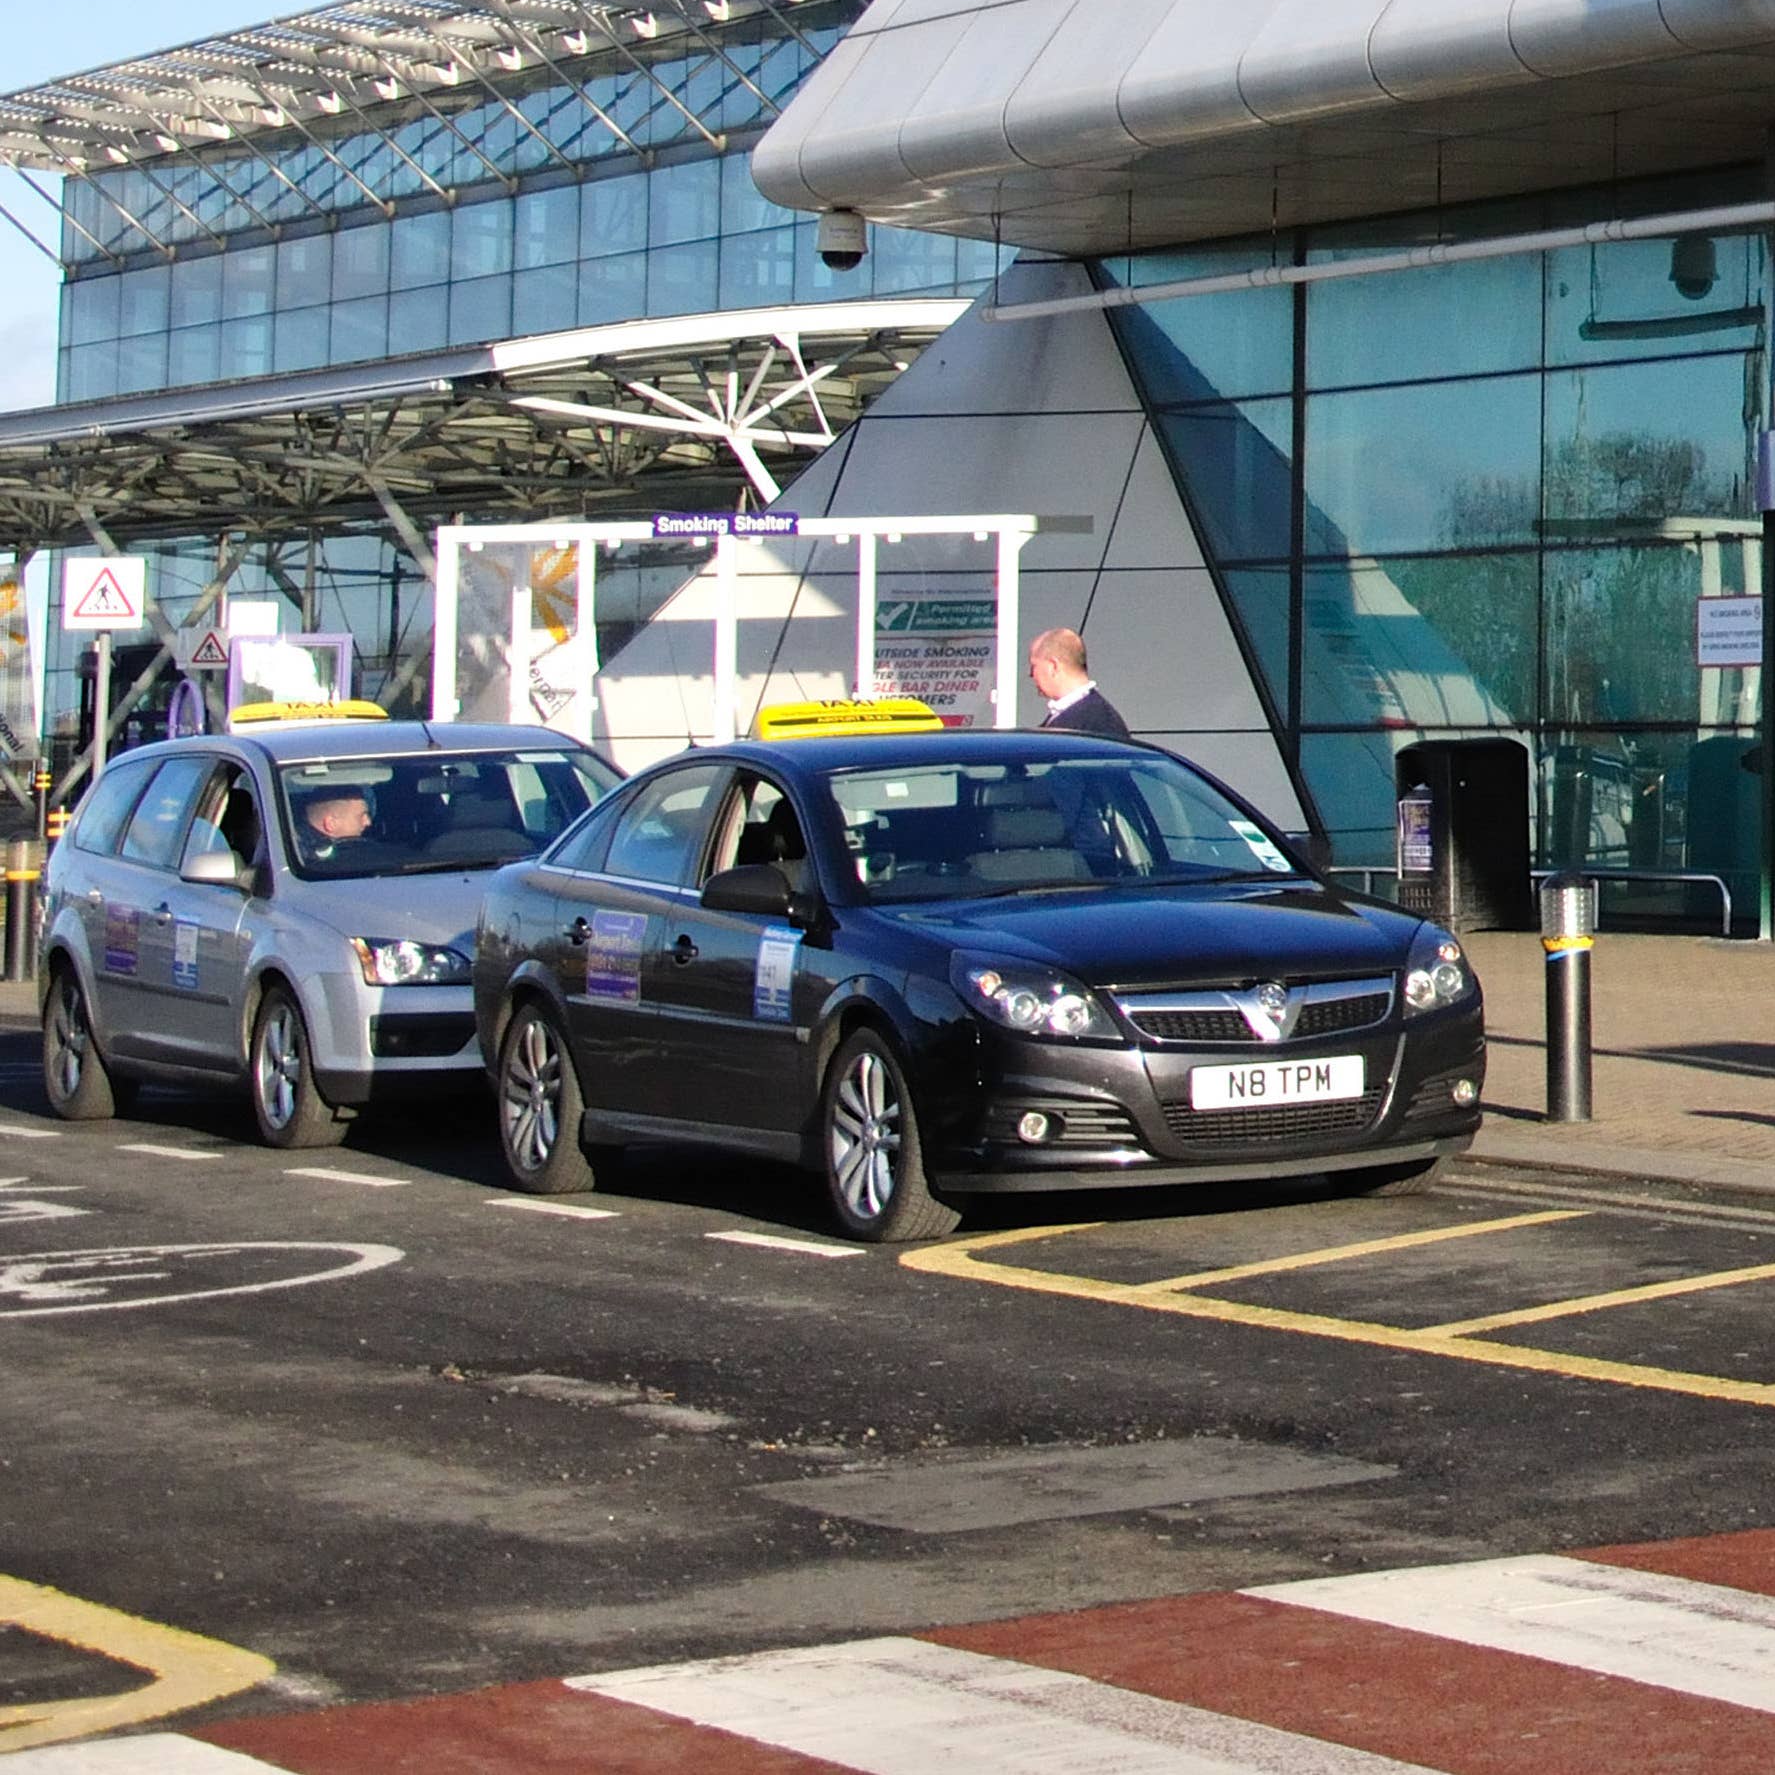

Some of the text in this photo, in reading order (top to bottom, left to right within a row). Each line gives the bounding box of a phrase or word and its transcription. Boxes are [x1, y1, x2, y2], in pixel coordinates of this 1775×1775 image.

[657, 515, 794, 535] Smoking Shelter
[924, 646, 990, 657] SMOKING
[954, 669, 980, 680] FOR
[901, 680, 931, 693] BAR
[934, 679, 980, 692] DINER
[1228, 1063, 1331, 1098] N8 TPM
